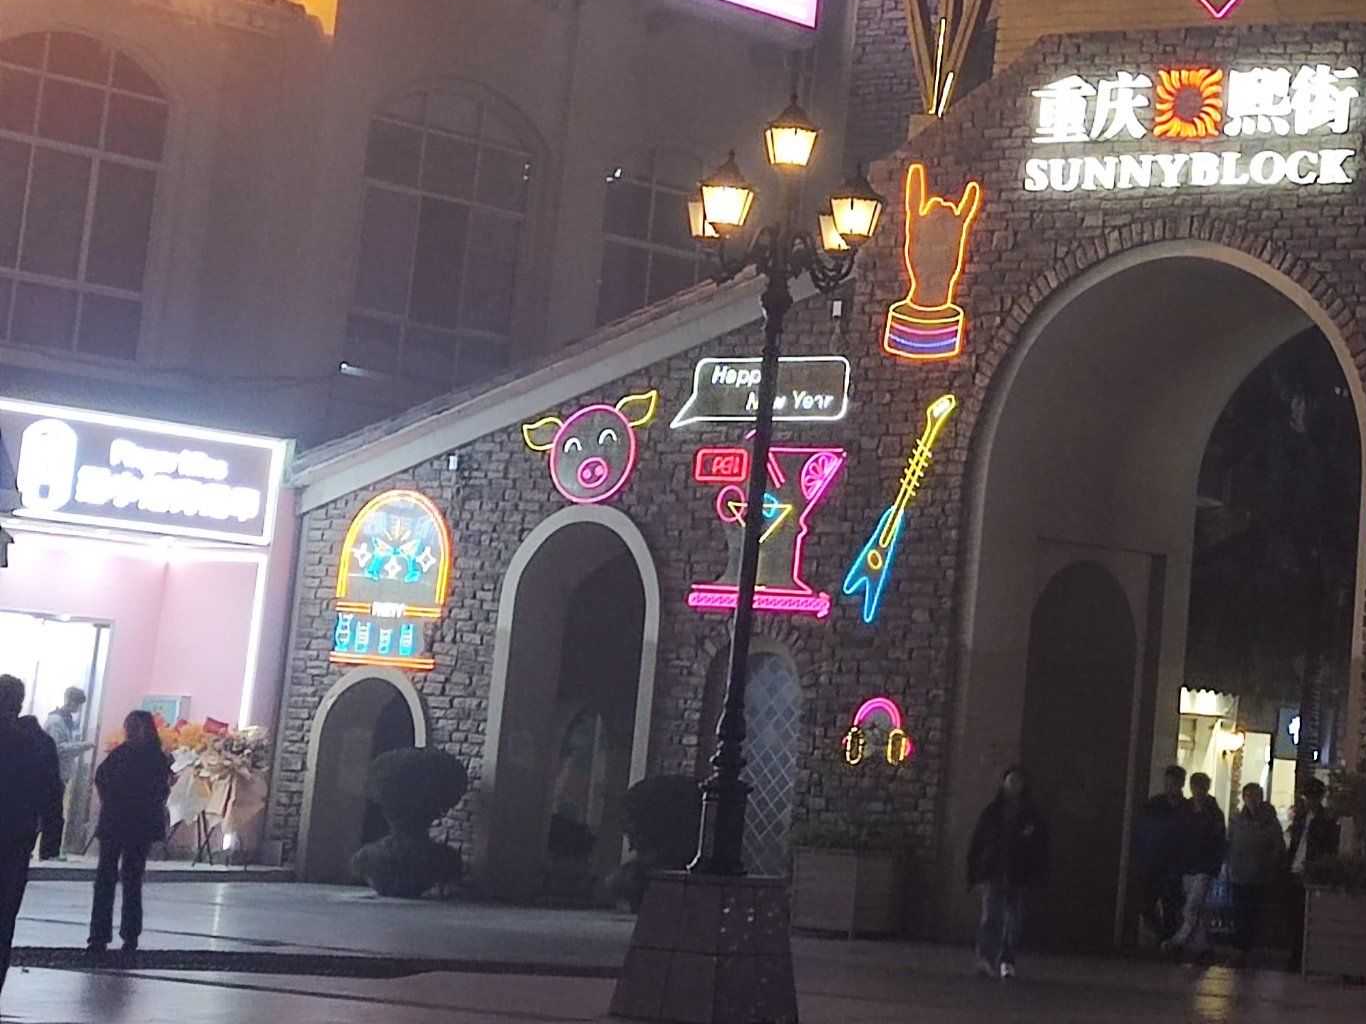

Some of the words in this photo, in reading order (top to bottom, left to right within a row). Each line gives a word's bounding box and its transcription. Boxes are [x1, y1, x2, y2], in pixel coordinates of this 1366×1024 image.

[1031, 71, 1154, 145] 重庆
[1223, 64, 1361, 138] 熙街
[1024, 148, 1355, 192] SUNNYBLOCK
[711, 365, 763, 388] Happ
[745, 391, 787, 411] Nw
[792, 390, 835, 411] Year
